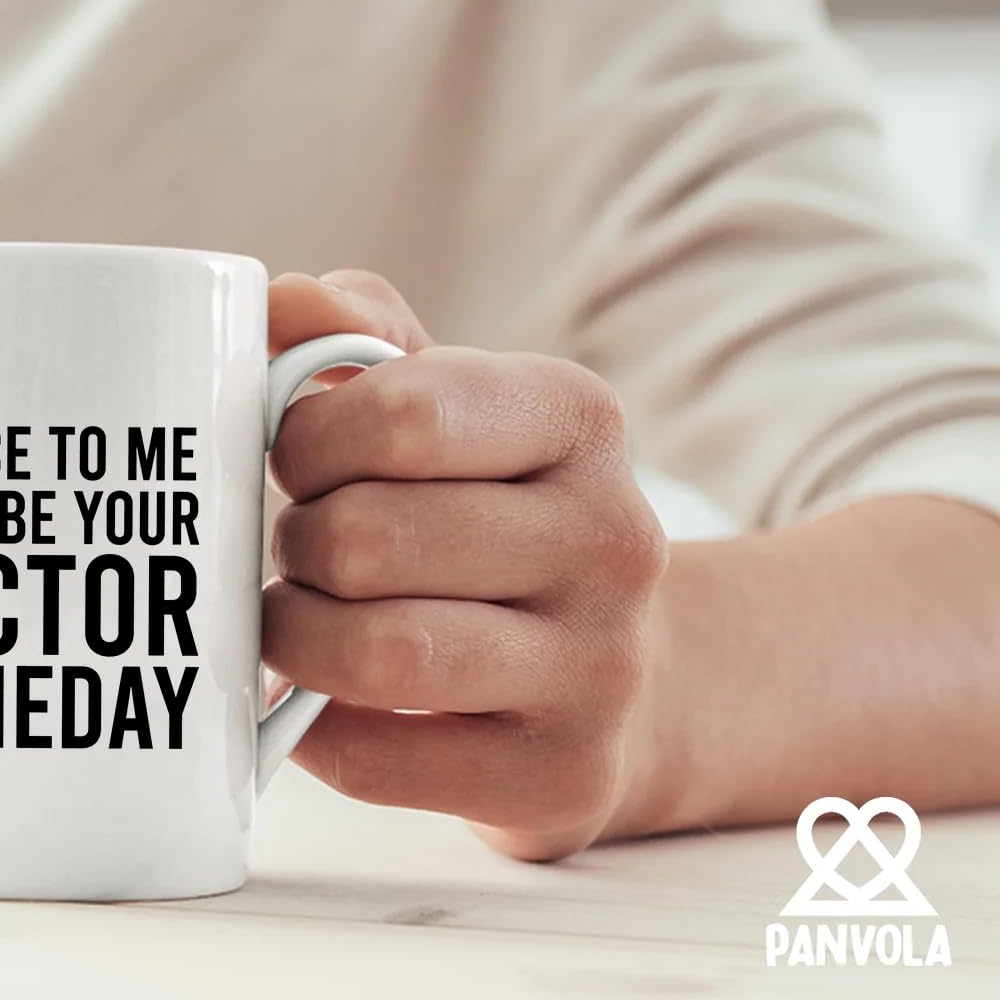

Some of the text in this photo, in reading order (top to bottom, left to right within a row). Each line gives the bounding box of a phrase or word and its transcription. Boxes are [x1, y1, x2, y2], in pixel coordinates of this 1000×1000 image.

[48, 425, 107, 482] TO
[127, 426, 197, 482] ME
[73, 490, 200, 546] YOUR
